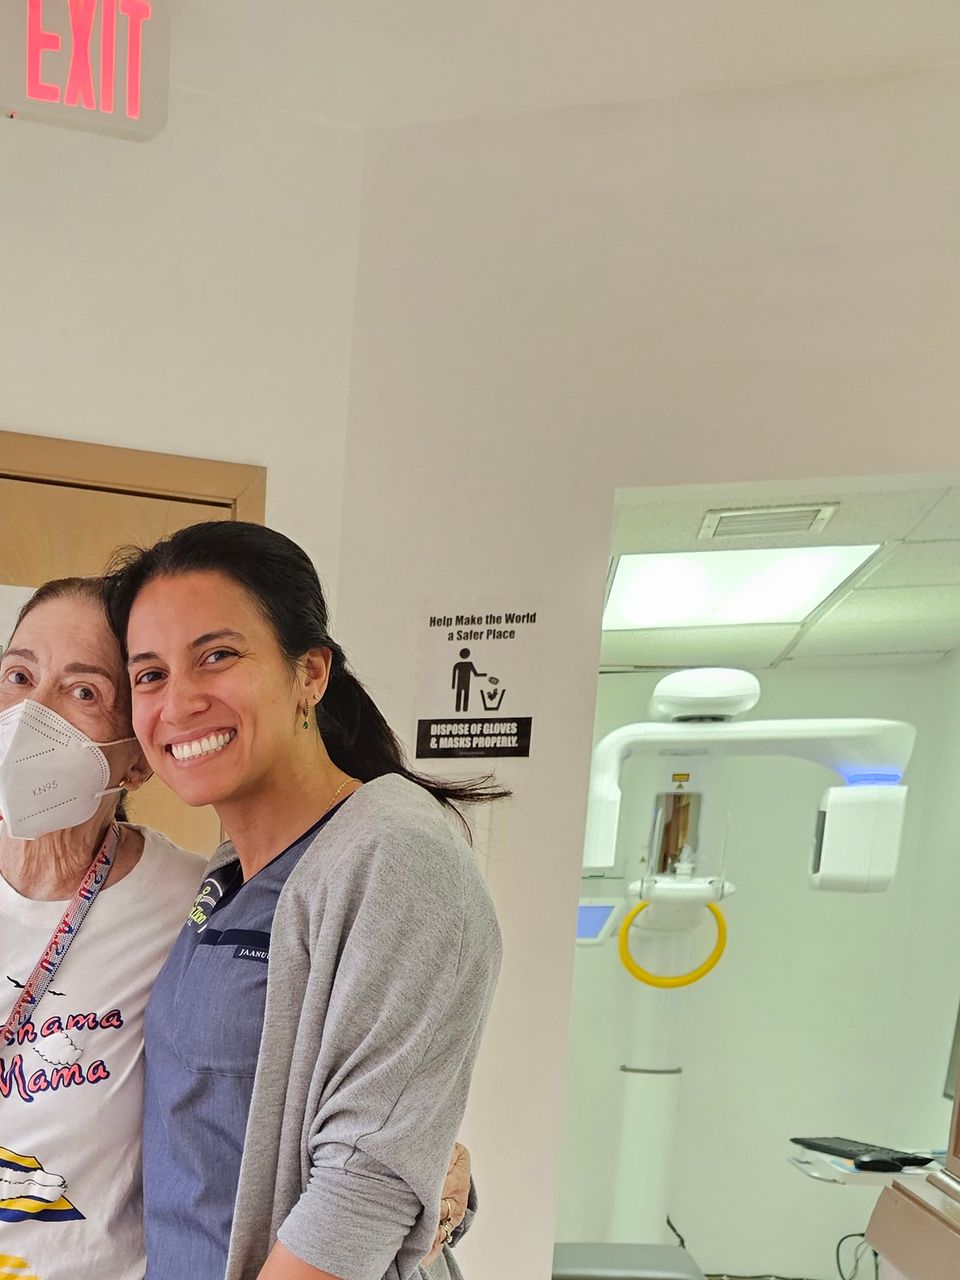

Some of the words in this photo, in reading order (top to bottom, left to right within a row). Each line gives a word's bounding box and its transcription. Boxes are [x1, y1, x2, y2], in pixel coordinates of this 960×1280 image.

[27, 0, 152, 120] EXIT
[429, 615, 453, 628] Help
[455, 614, 483, 627] Make
[485, 613, 502, 626] the
[504, 612, 537, 625] World
[447, 632, 454, 642] a
[456, 630, 484, 641] Safer
[486, 628, 516, 640] Place
[430, 723, 470, 736] DISPOSE
[470, 723, 483, 735] OF
[483, 722, 518, 735] GLOVES
[429, 737, 438, 749] &
[438, 737, 472, 749] MASKS
[472, 735, 519, 749] PROPERLY.
[31, 779, 59, 798] KN95
